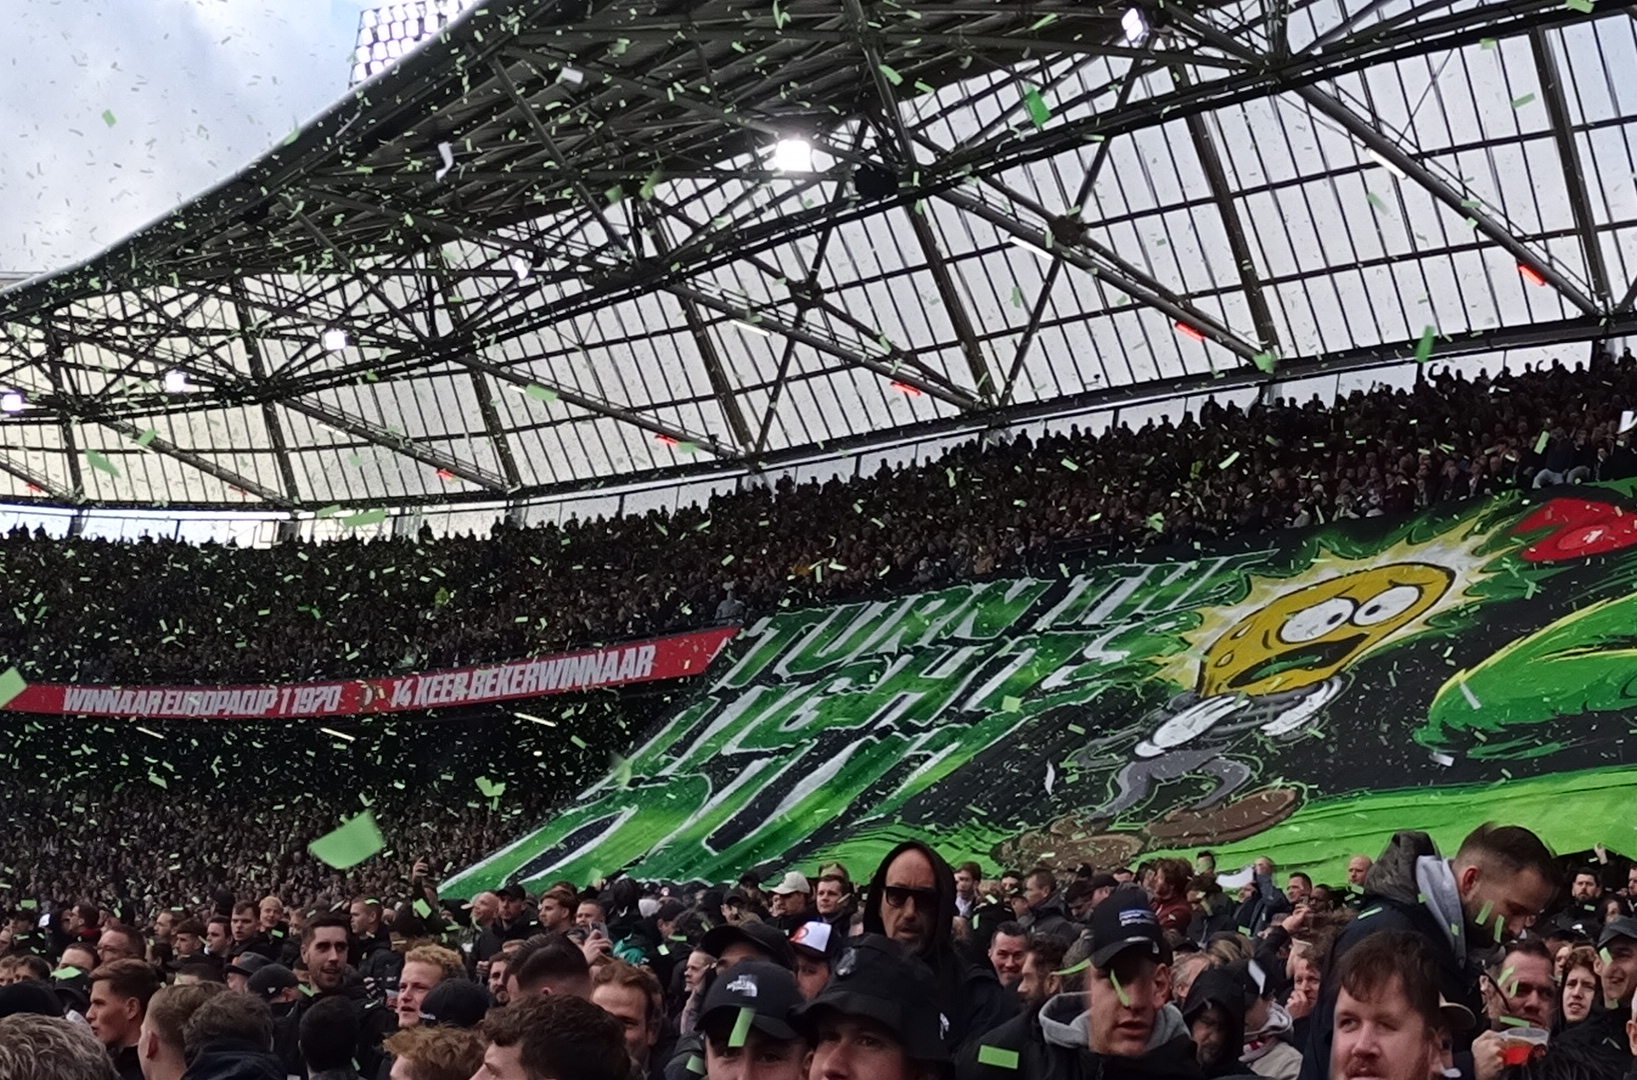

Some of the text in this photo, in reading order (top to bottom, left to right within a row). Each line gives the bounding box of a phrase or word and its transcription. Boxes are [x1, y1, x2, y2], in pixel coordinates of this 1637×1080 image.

[390, 645, 655, 707] 14 KEER BEKERWINNAAR
[708, 549, 1281, 695] TURN THE
[63, 688, 163, 715] WINNAAR
[291, 685, 342, 714] 1970
[574, 608, 1204, 800] LIGHTS
[437, 680, 1112, 898] OUT
